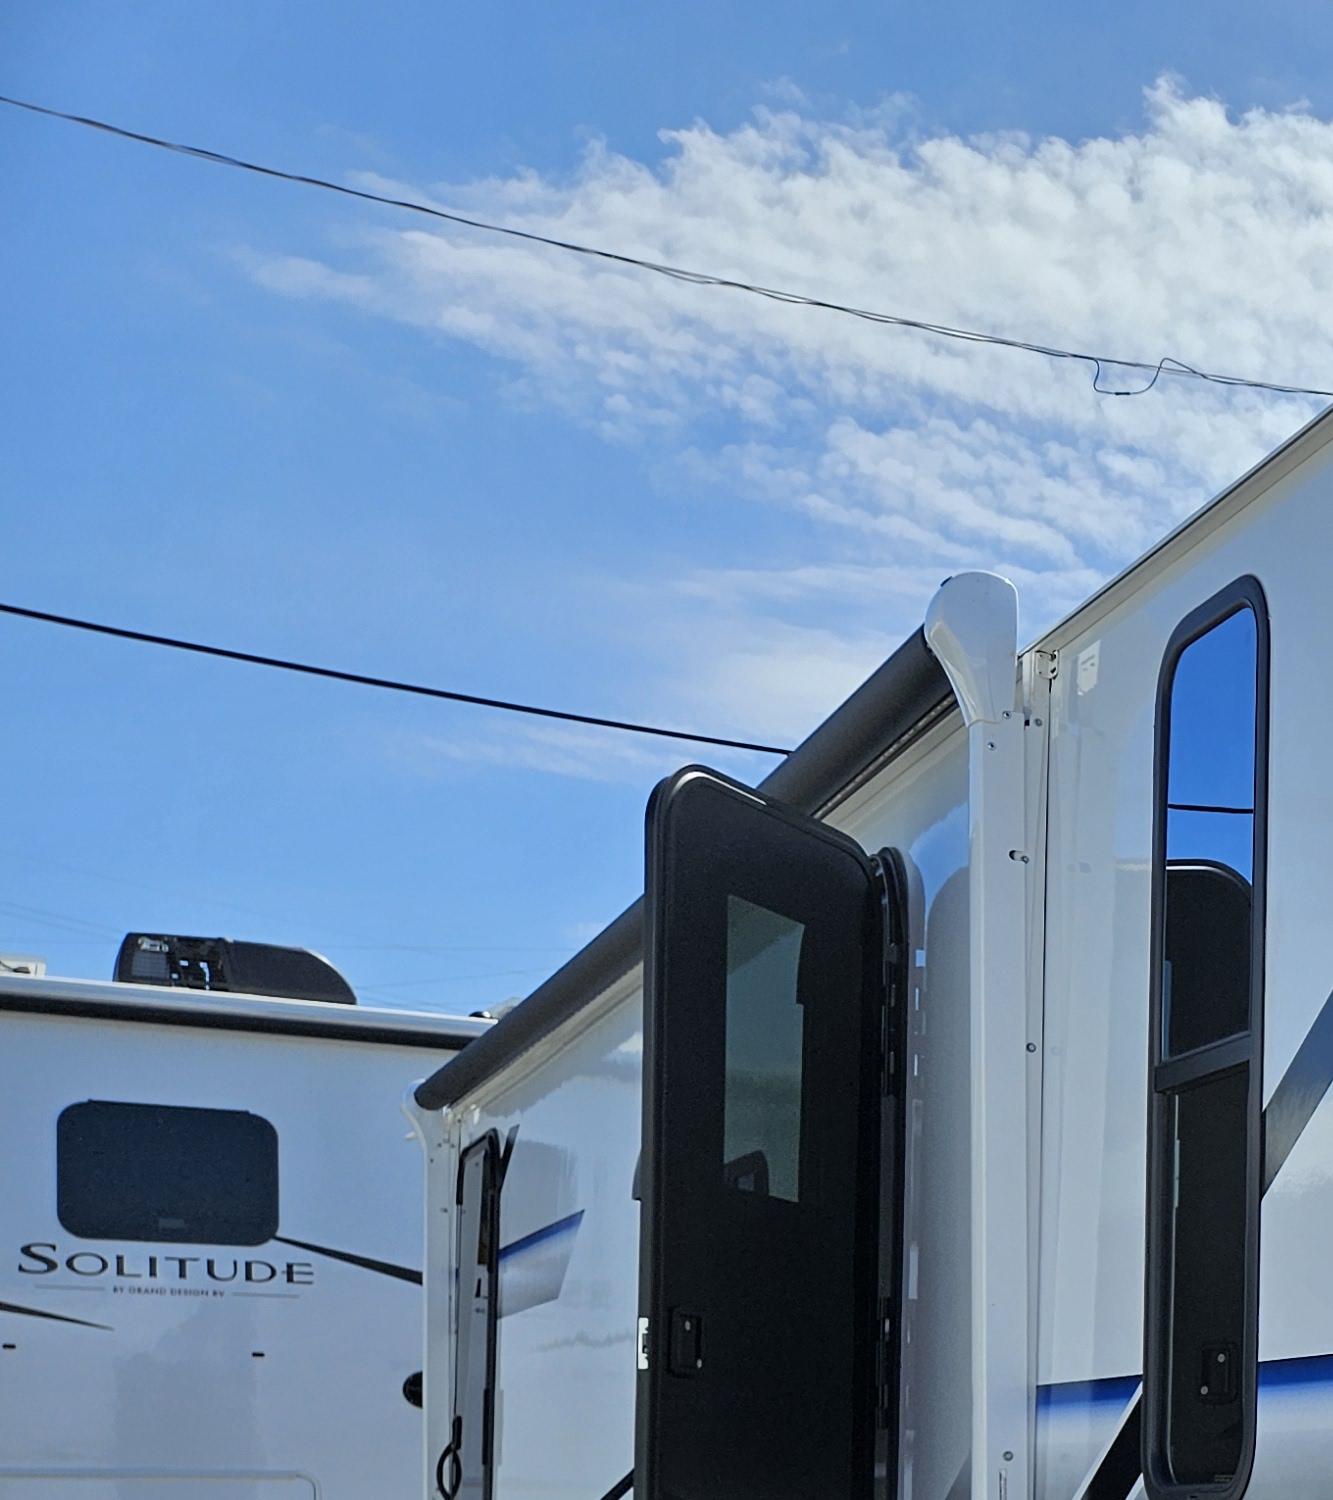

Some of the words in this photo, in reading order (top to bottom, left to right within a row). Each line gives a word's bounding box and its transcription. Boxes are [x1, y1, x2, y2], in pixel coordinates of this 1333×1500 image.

[17, 1242, 315, 1285] SOLITUDE
[113, 1285, 125, 1295] BY
[128, 1285, 167, 1296] GRAND
[170, 1287, 209, 1298] DESIGN
